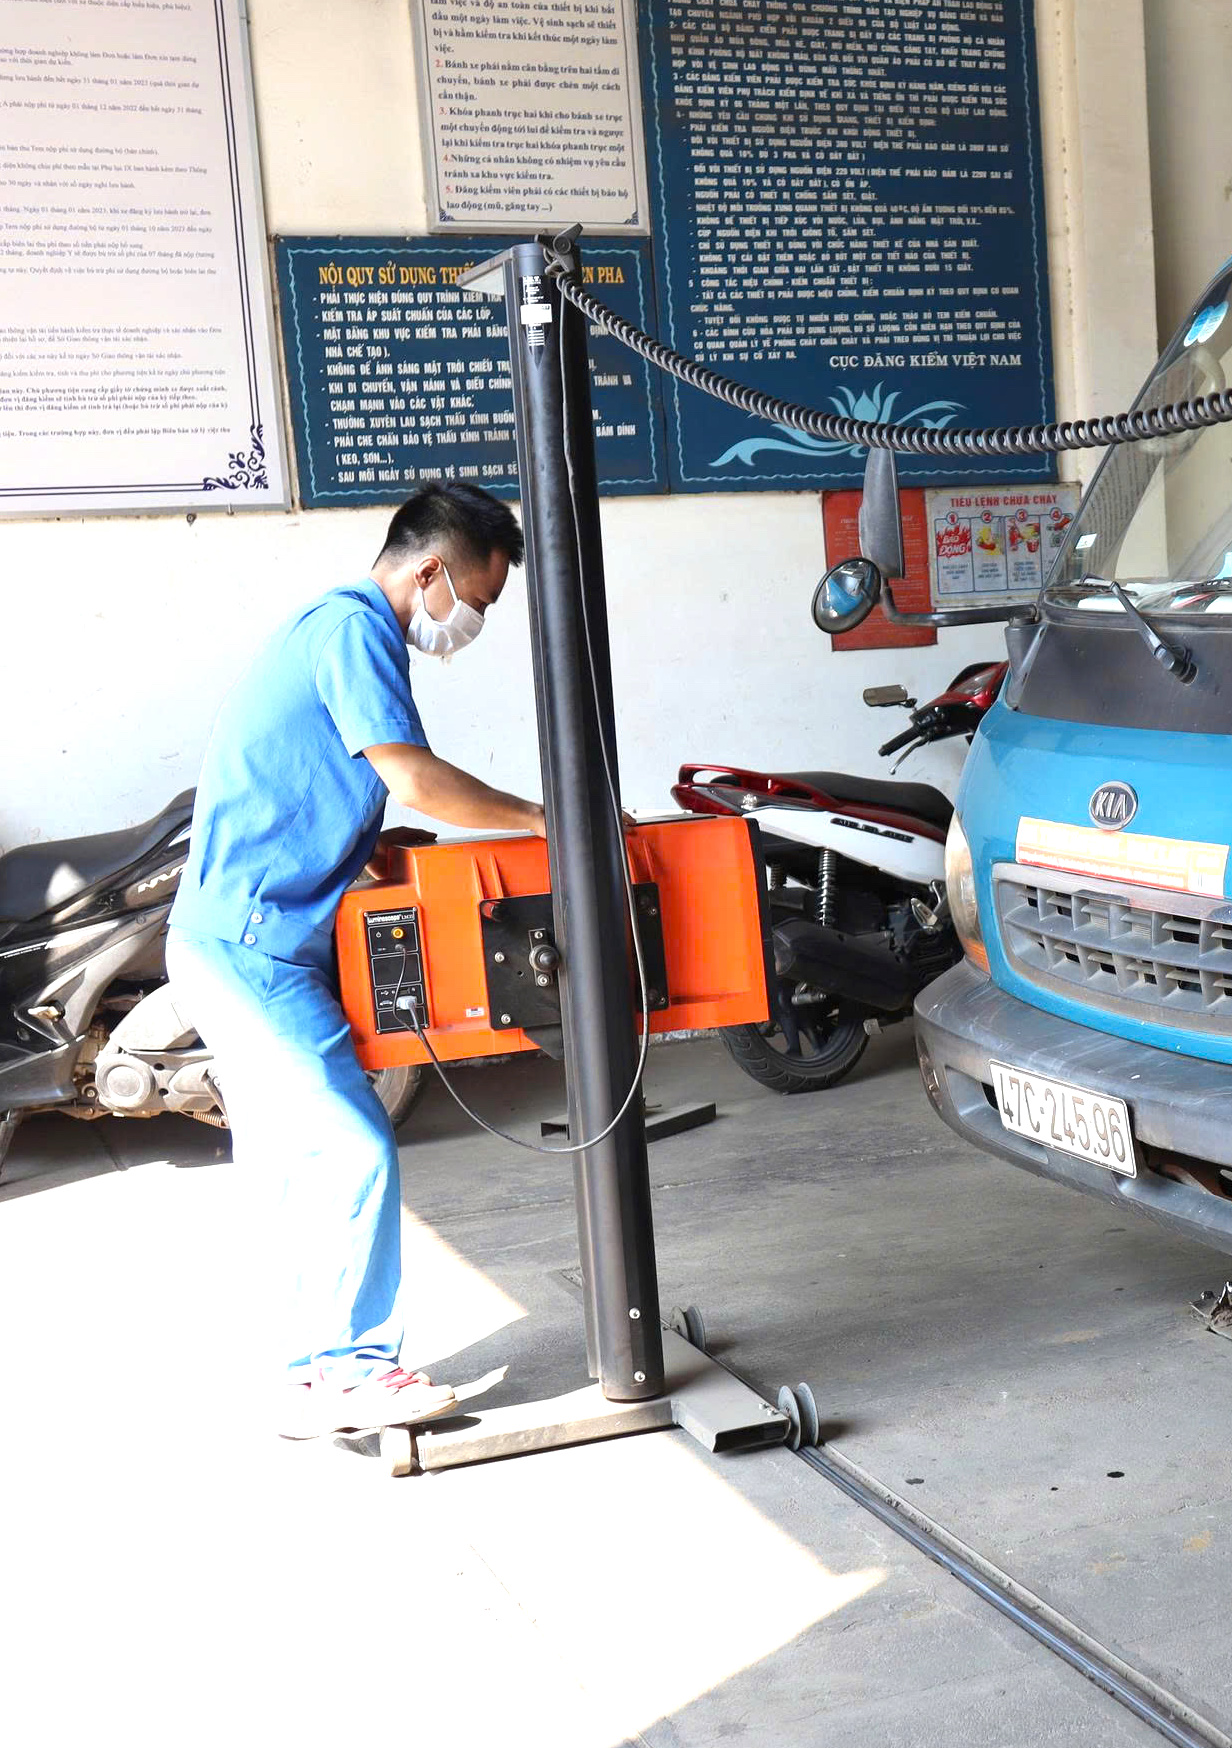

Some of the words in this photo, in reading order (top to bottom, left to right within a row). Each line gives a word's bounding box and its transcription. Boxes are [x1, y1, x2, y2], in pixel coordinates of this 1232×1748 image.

[319, 260, 343, 287] NỘI
[347, 267, 374, 287] QUY
[379, 260, 396, 284] SỬ
[400, 267, 436, 288] DỤNG
[598, 267, 624, 283] PHA
[417, 292, 433, 304] QUY
[497, 360, 511, 374] TRỰ
[830, 355, 859, 371] CỤC
[864, 352, 905, 367] ĐĂNG
[910, 351, 948, 367] KIỂM
[952, 352, 986, 369] VIỆT
[990, 354, 1022, 366] NAM
[1094, 791, 1127, 820] KIA
